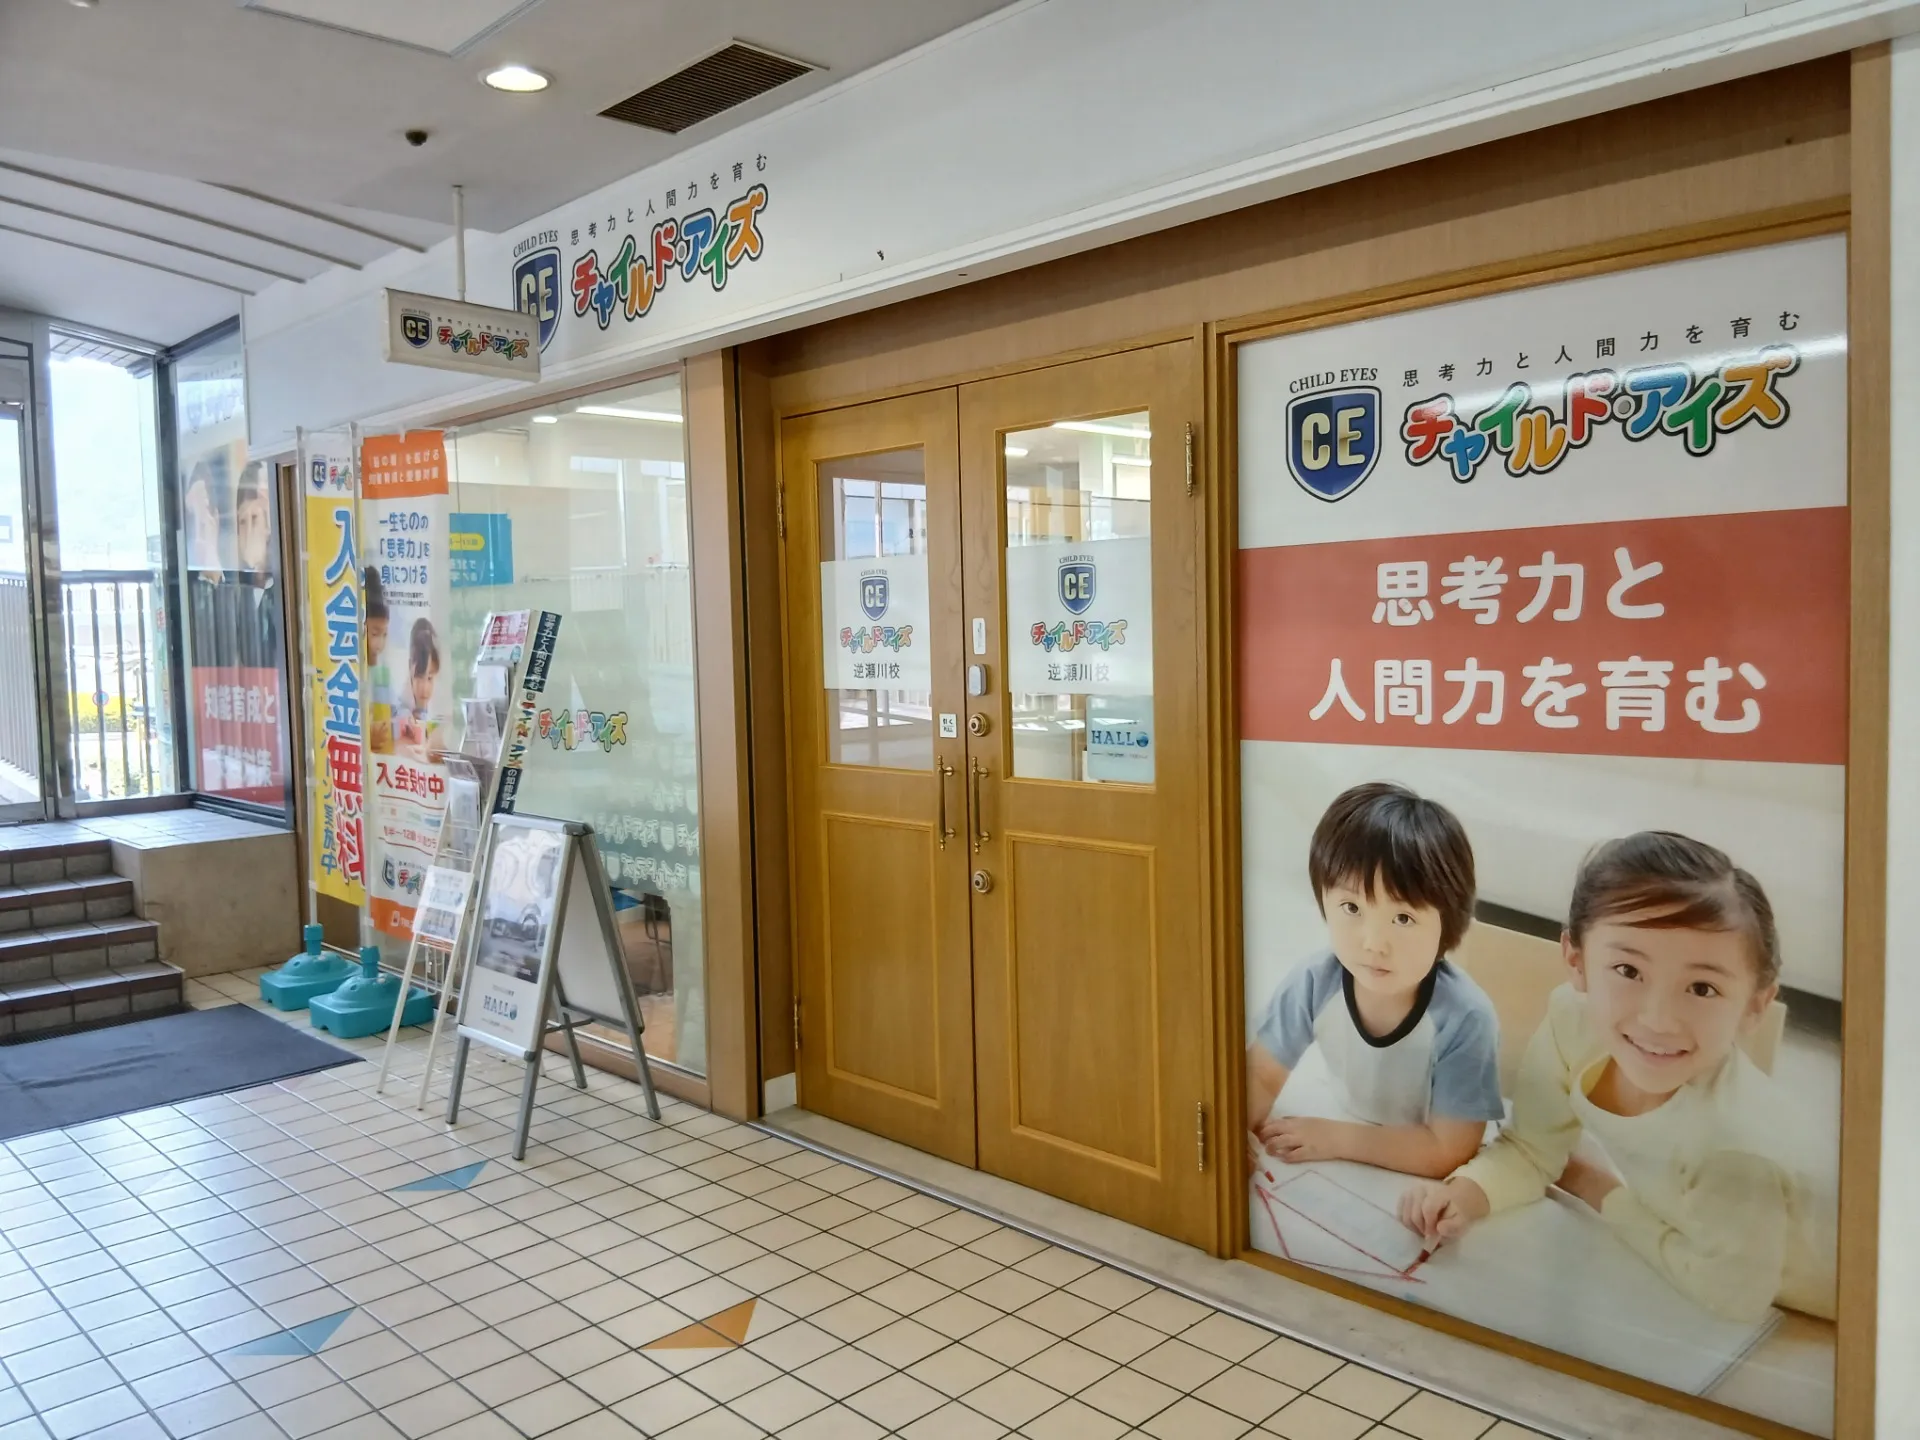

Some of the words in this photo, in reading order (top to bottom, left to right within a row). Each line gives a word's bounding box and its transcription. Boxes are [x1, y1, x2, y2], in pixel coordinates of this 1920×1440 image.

[571, 153, 767, 246] 思考力と人間力を育む
[513, 238, 537, 258] CHILD
[538, 229, 559, 245] EYES
[571, 183, 768, 330] チャイルド・アイズ
[520, 265, 555, 322] CE
[405, 319, 428, 340] CE
[1402, 310, 1800, 388] 思考力と人間力を育む
[1289, 370, 1335, 394] CHILD
[1339, 366, 1378, 384] EYES
[1399, 343, 1801, 484] チャイルド・アイズ
[1301, 406, 1368, 471] CE
[379, 511, 429, 532] 一生ものの
[380, 537, 430, 559] 「思考力」を
[1059, 555, 1076, 564] CHILD
[1078, 554, 1094, 563] EYES
[381, 564, 428, 584] 身につける
[1063, 572, 1090, 600] CE
[1372, 547, 1665, 627] 思考力と
[864, 584, 885, 608] CE
[853, 662, 900, 680] 逆瀬川校
[1047, 662, 1110, 682] 逆瀬川校
[1308, 655, 1767, 734] 人間力を育む
[376, 762, 445, 800] 入会受付中
